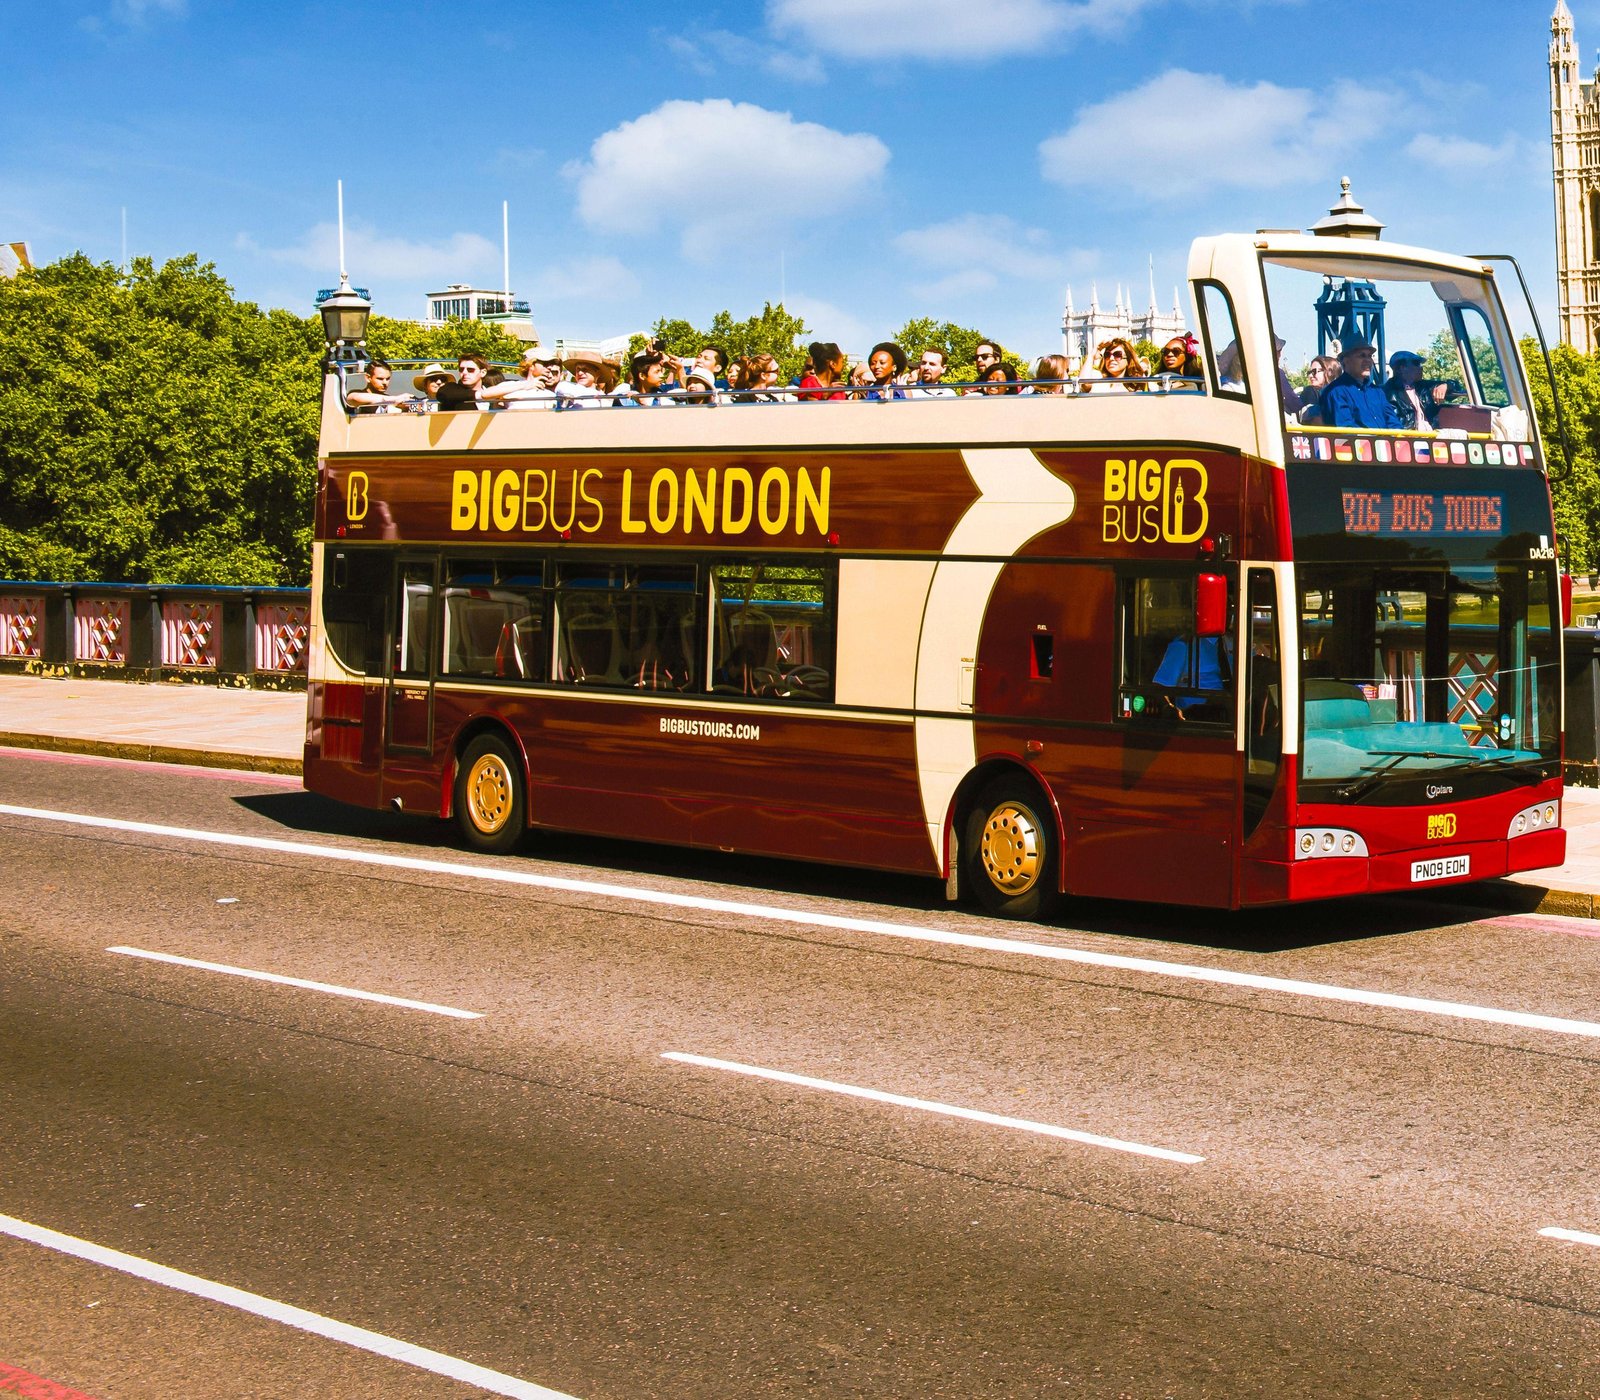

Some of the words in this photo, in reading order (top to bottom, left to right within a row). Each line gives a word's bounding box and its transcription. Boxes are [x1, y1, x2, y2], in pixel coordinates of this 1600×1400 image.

[1103, 458, 1161, 502] BIG
[621, 466, 831, 536] LONDON
[1391, 494, 1433, 531] BUS
[1443, 495, 1502, 532] TOURS
[1102, 504, 1160, 543] BUS
[660, 717, 760, 741] BIGBUSTOURS.COM
[1427, 827, 1444, 840] BUS
[1428, 814, 1444, 828] BIG
[1415, 862, 1443, 879] PN09
[1446, 858, 1466, 875] EOH
